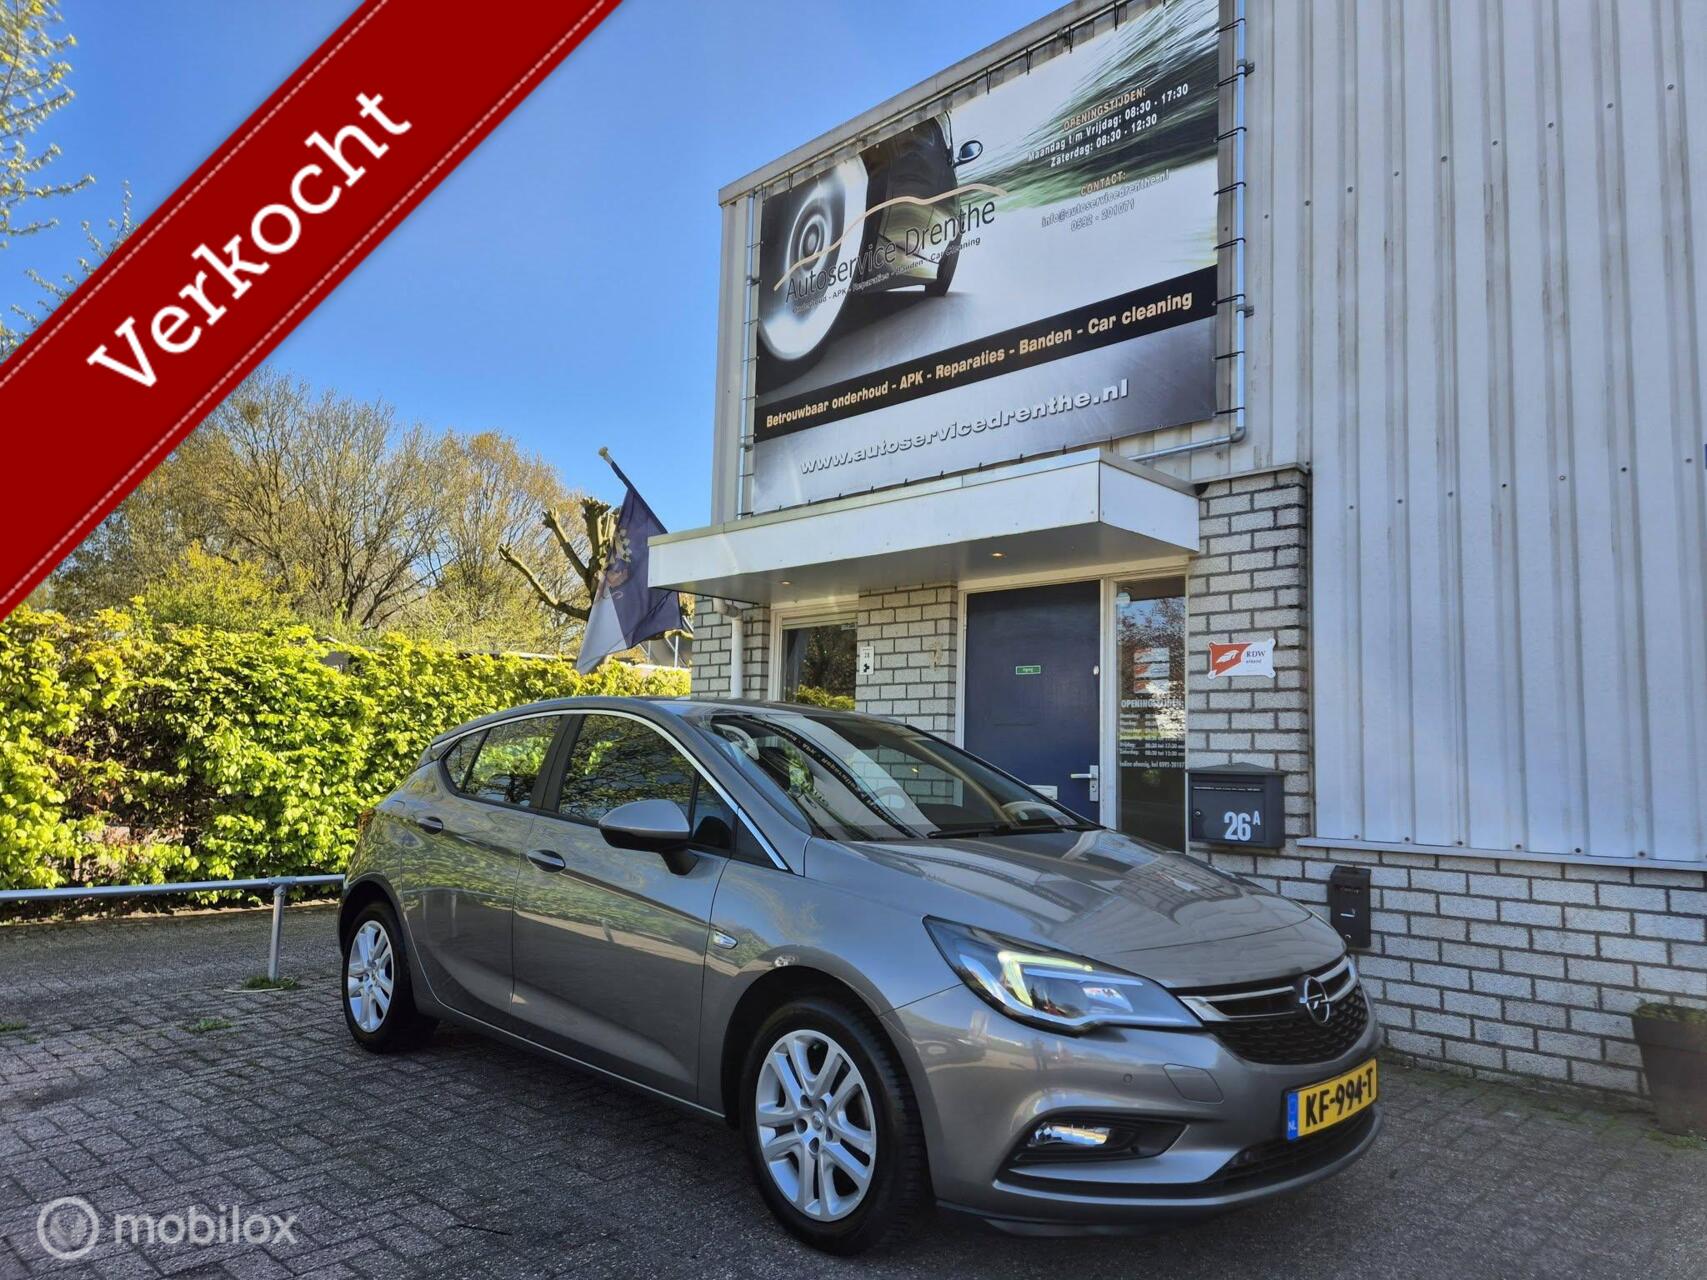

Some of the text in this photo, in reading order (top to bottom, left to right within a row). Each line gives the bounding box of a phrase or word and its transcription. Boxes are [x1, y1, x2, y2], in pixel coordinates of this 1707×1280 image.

[1028, 139, 1066, 161] Maandag
[1086, 114, 1122, 136] Vrijdag:
[1124, 100, 1151, 120] 08:30
[1161, 83, 1189, 104] 17:30
[1063, 87, 1146, 131] OPENINGSTIJDEN:
[1050, 143, 1094, 167] Zaterdag:
[1096, 129, 1121, 148] 08:30
[1131, 114, 1157, 132] 12:30
[1080, 171, 1127, 196] CONTACT:
[786, 201, 995, 303] Autoservice Drenthe
[832, 288, 848, 299] APK
[766, 400, 829, 428] Betrouwbaar
[832, 381, 888, 409] onderhoud
[900, 370, 924, 390] APK
[935, 347, 1005, 379] Reparaties
[1019, 327, 1072, 355] Banden
[1088, 315, 1116, 335] Car
[1121, 292, 1193, 324] cleaning
[800, 378, 1130, 475] www.autoservicedrenthe.nl
[1305, 1067, 1374, 1128] KF-994-T
